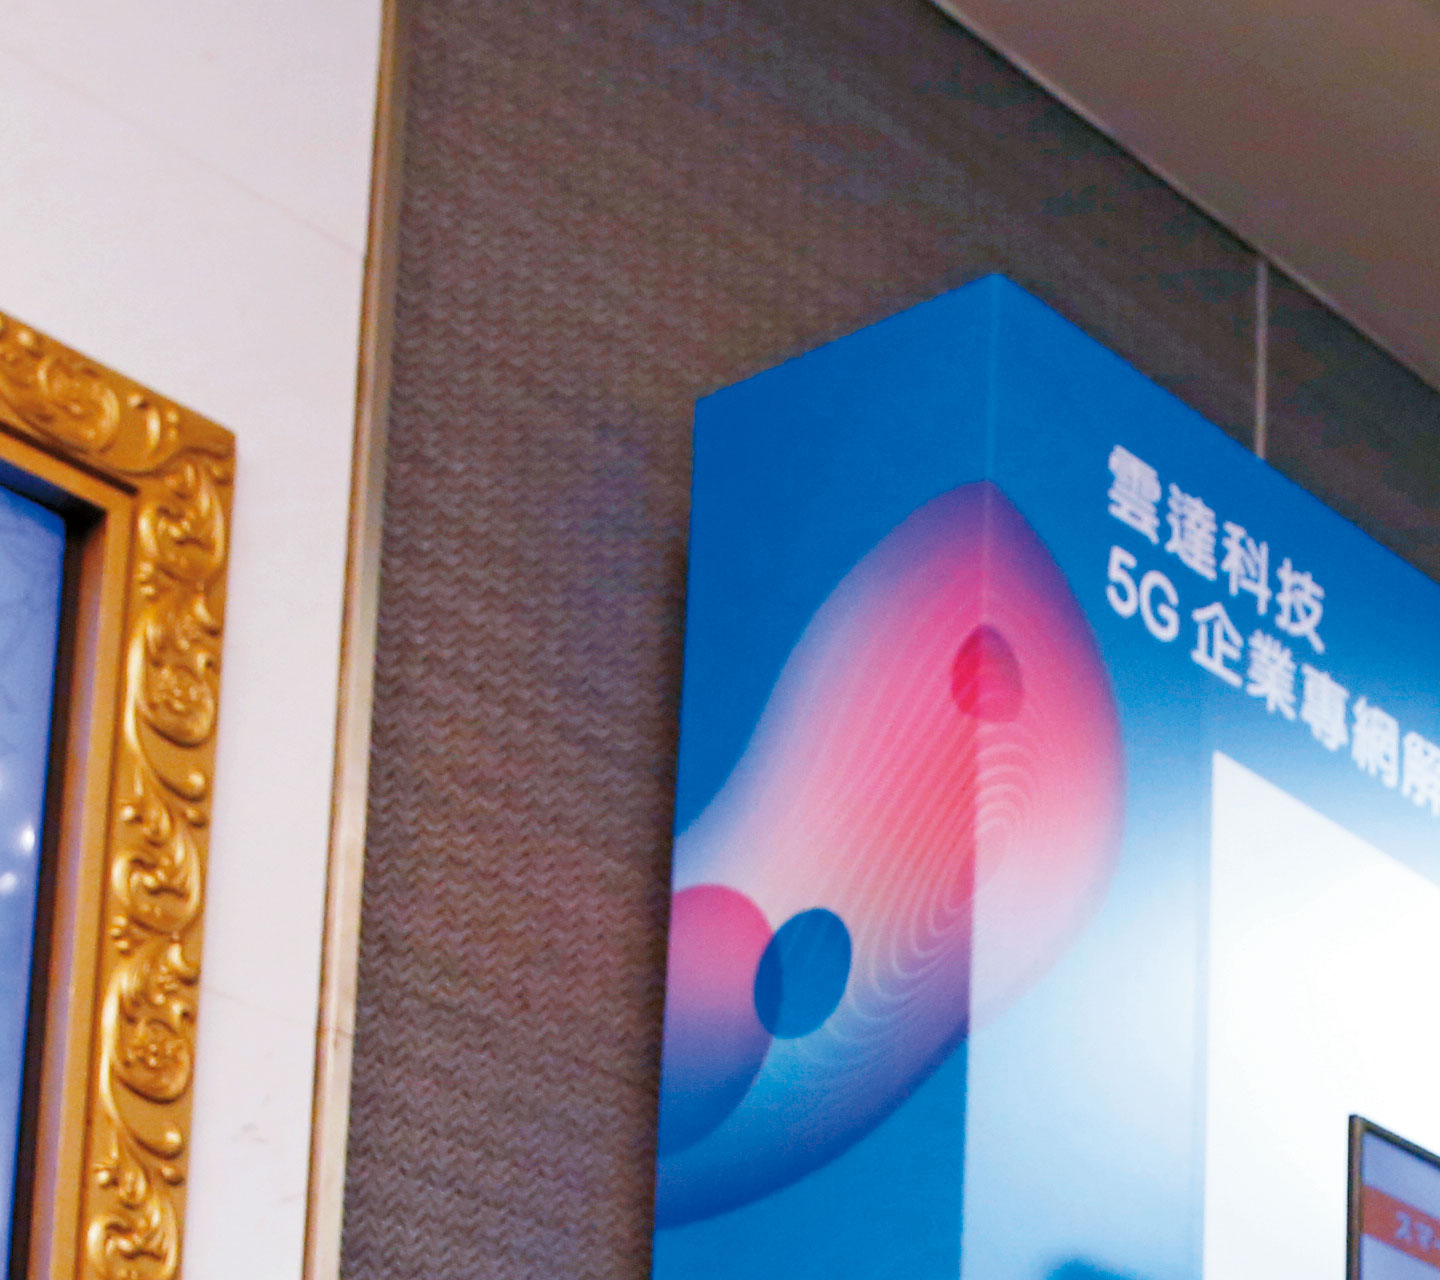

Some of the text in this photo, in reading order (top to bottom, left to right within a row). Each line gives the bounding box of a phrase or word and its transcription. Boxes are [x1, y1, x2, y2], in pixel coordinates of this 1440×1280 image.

[1106, 549, 1180, 643] 5G
[1108, 444, 1326, 654] 雲達科技
